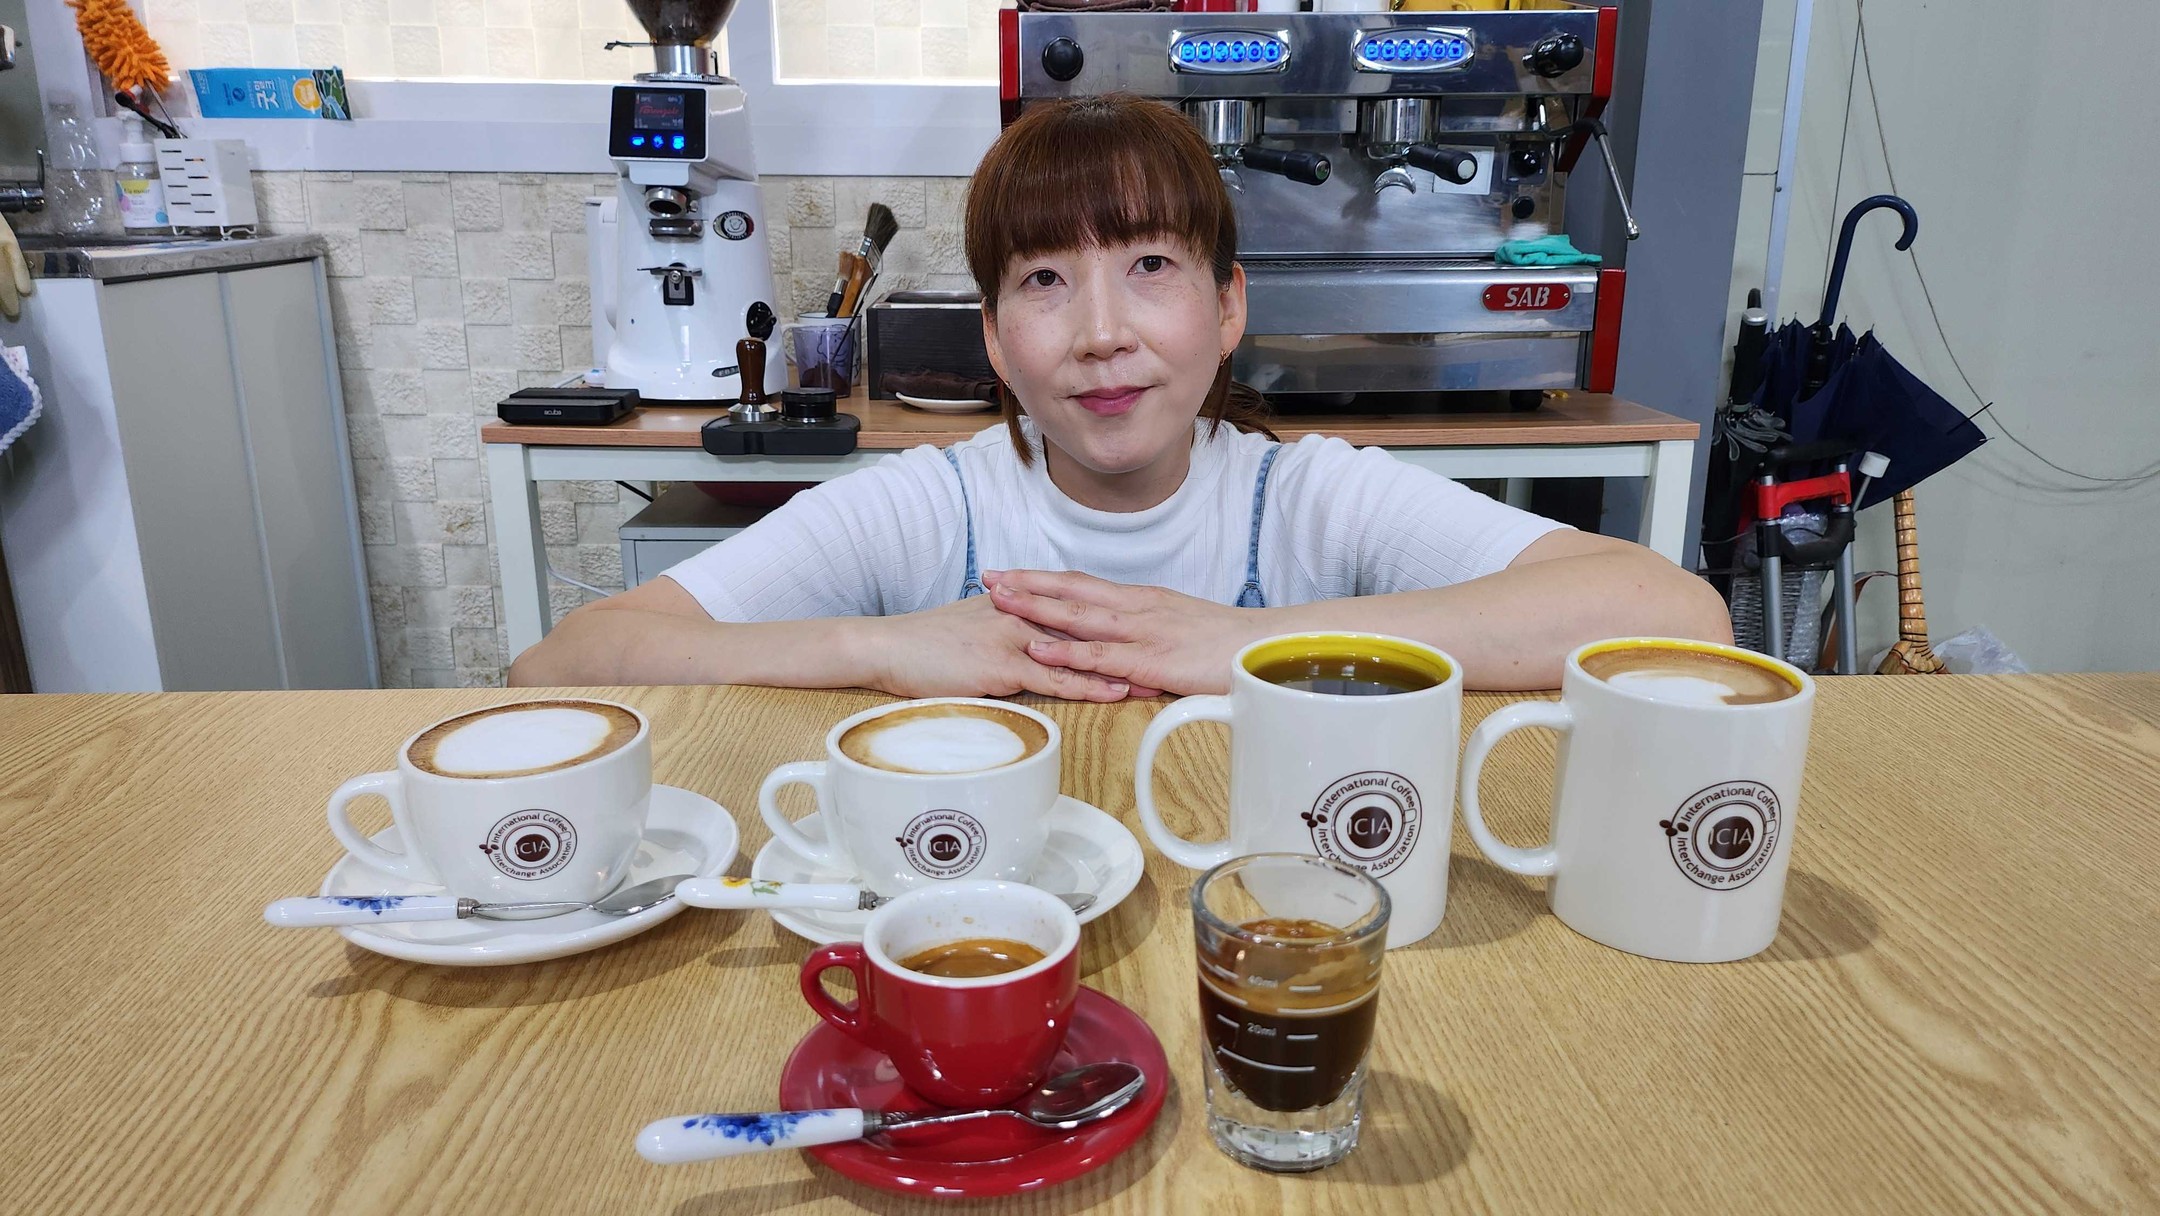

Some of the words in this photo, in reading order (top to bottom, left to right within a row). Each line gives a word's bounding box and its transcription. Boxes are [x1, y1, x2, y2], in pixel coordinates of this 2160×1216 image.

[1504, 287, 1550, 308] SAB
[1319, 777, 1389, 813] International
[1391, 780, 1416, 808] Coffee
[1680, 787, 1756, 822] International
[1757, 790, 1776, 819] Coffee
[491, 813, 540, 844] International
[543, 813, 568, 832] Coffee
[908, 813, 956, 838] International
[957, 816, 980, 836] Coffee
[1348, 818, 1392, 835] ICIA
[1709, 828, 1753, 845] ICIA
[493, 852, 537, 878] Interchange
[539, 841, 572, 875] Association
[514, 840, 551, 855] ICIA
[908, 847, 945, 876] Interchange
[948, 846, 981, 875] Association
[928, 841, 961, 853] ICIA
[1371, 824, 1416, 872] Association
[1677, 837, 1725, 884] Interchange
[1728, 835, 1774, 883] Association
